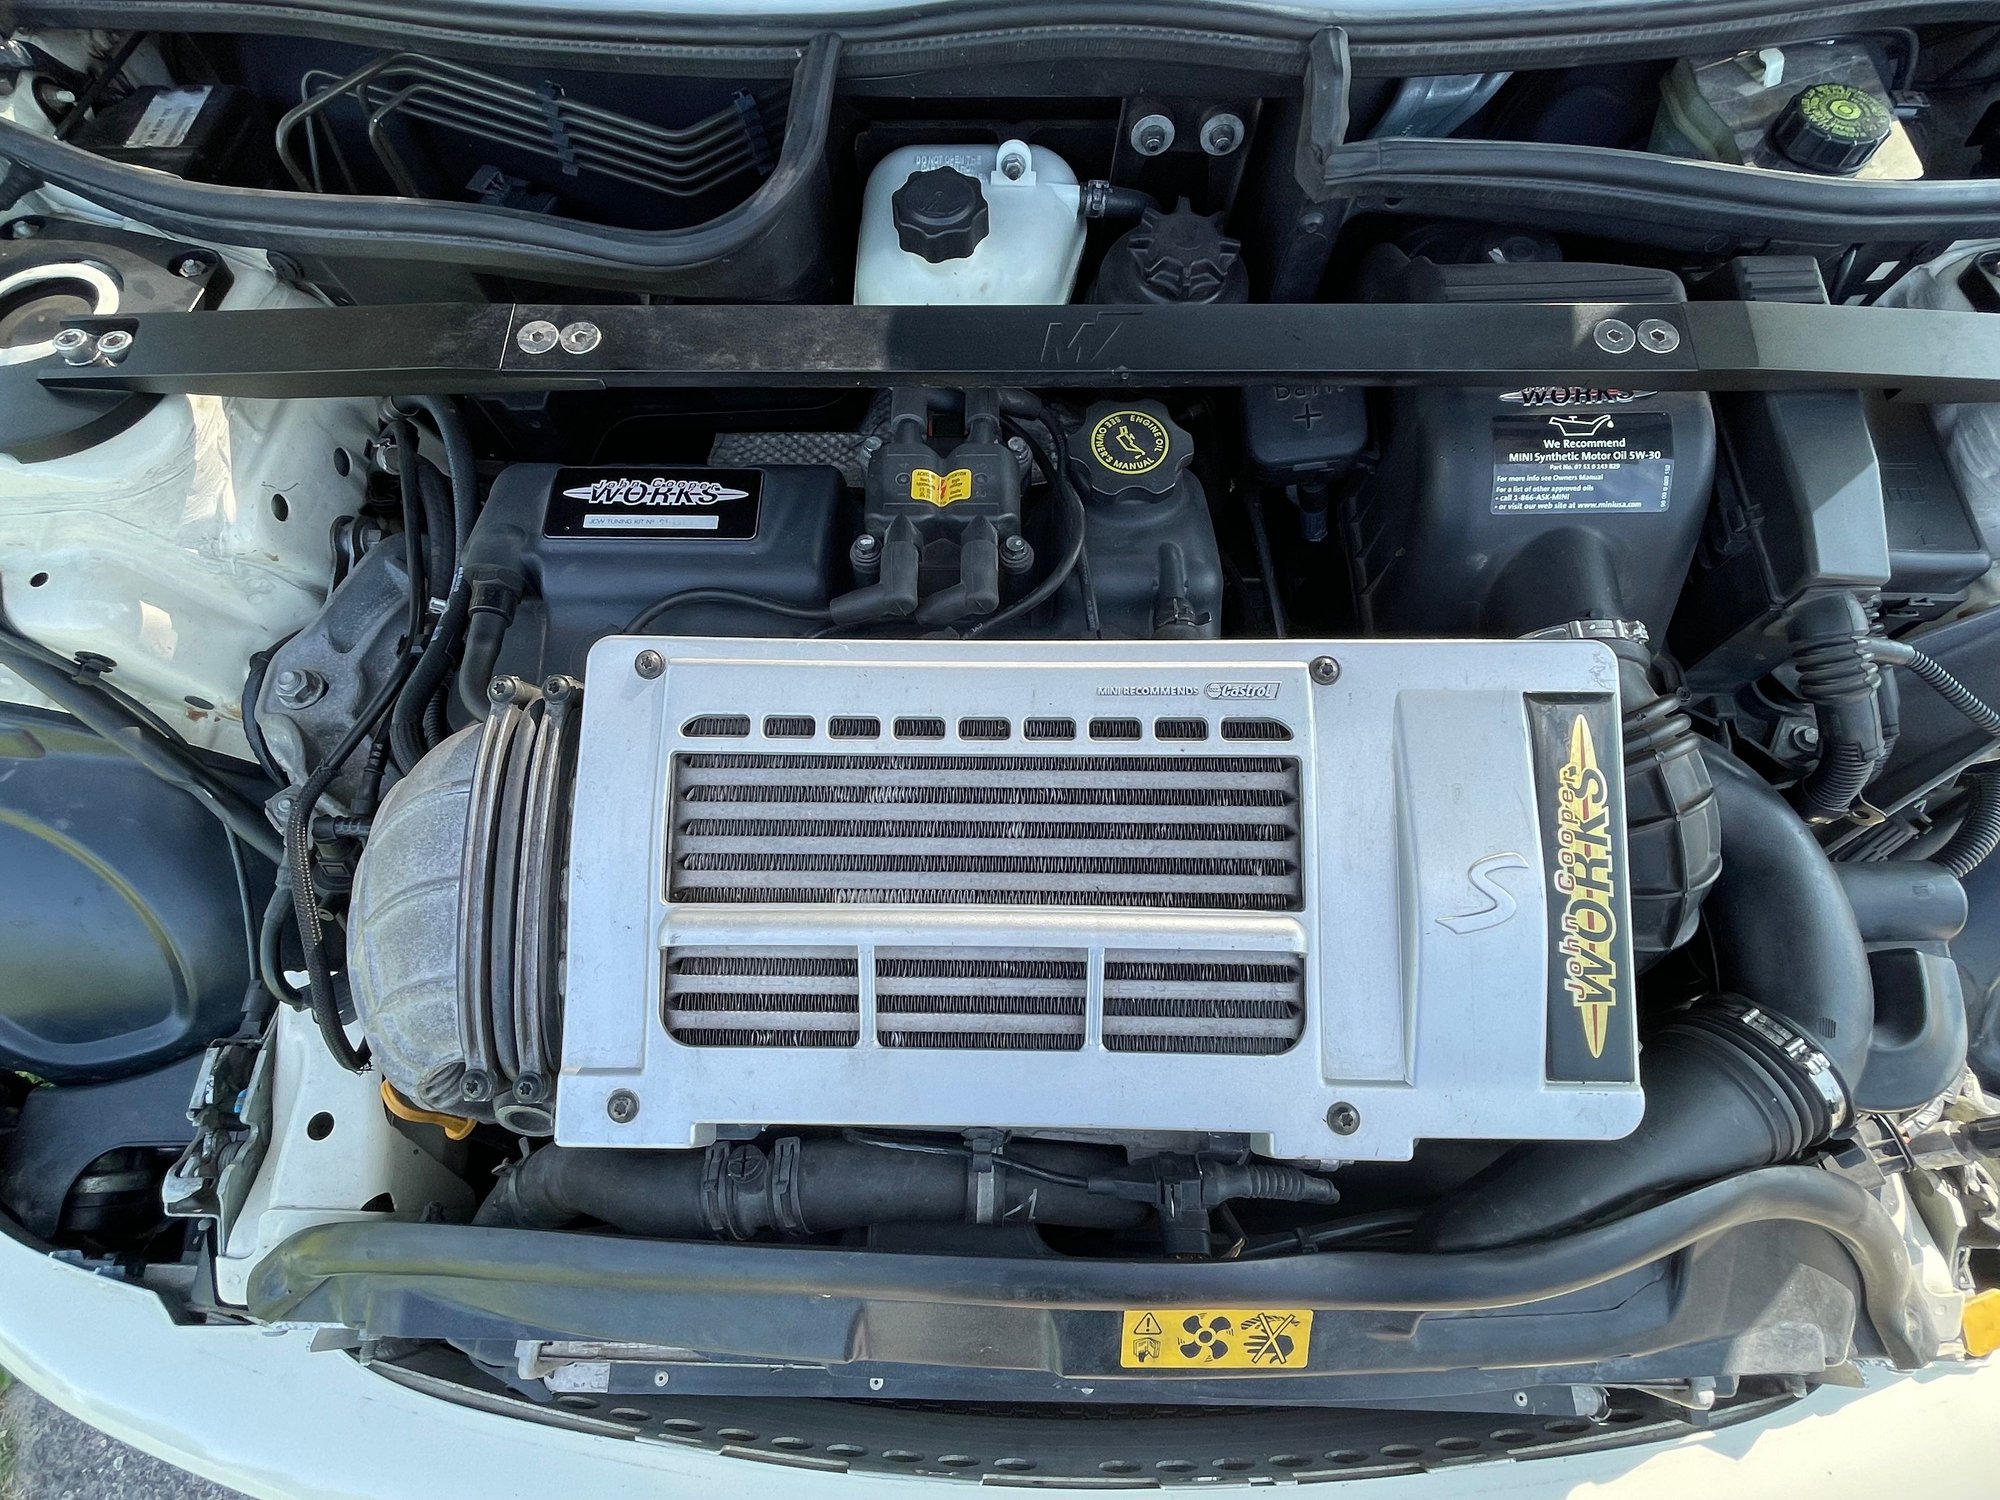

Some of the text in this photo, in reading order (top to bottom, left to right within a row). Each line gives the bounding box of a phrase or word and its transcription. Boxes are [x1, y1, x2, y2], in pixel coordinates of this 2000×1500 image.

[1129, 415, 1164, 452] ENGINE OIL
[1095, 416, 1155, 470] SEE OWNER'S MANUAL
[1543, 438, 1626, 449] We Recommend
[1509, 451, 1661, 463] MINI Synthetic Motor Oil 5W-30
[594, 477, 722, 491] John Cooper
[1551, 485, 1581, 493] approved
[588, 482, 722, 505] WORKS
[1577, 501, 1642, 509] www.miniusa.com
[1097, 686, 1121, 696] MINI
[1122, 686, 1199, 696] RECOMMENDS
[1220, 683, 1272, 698] Castrol
[1555, 763, 1588, 1001] John Cooper
[1570, 767, 1617, 1007] WORKS
[1435, 852, 1529, 935] S
